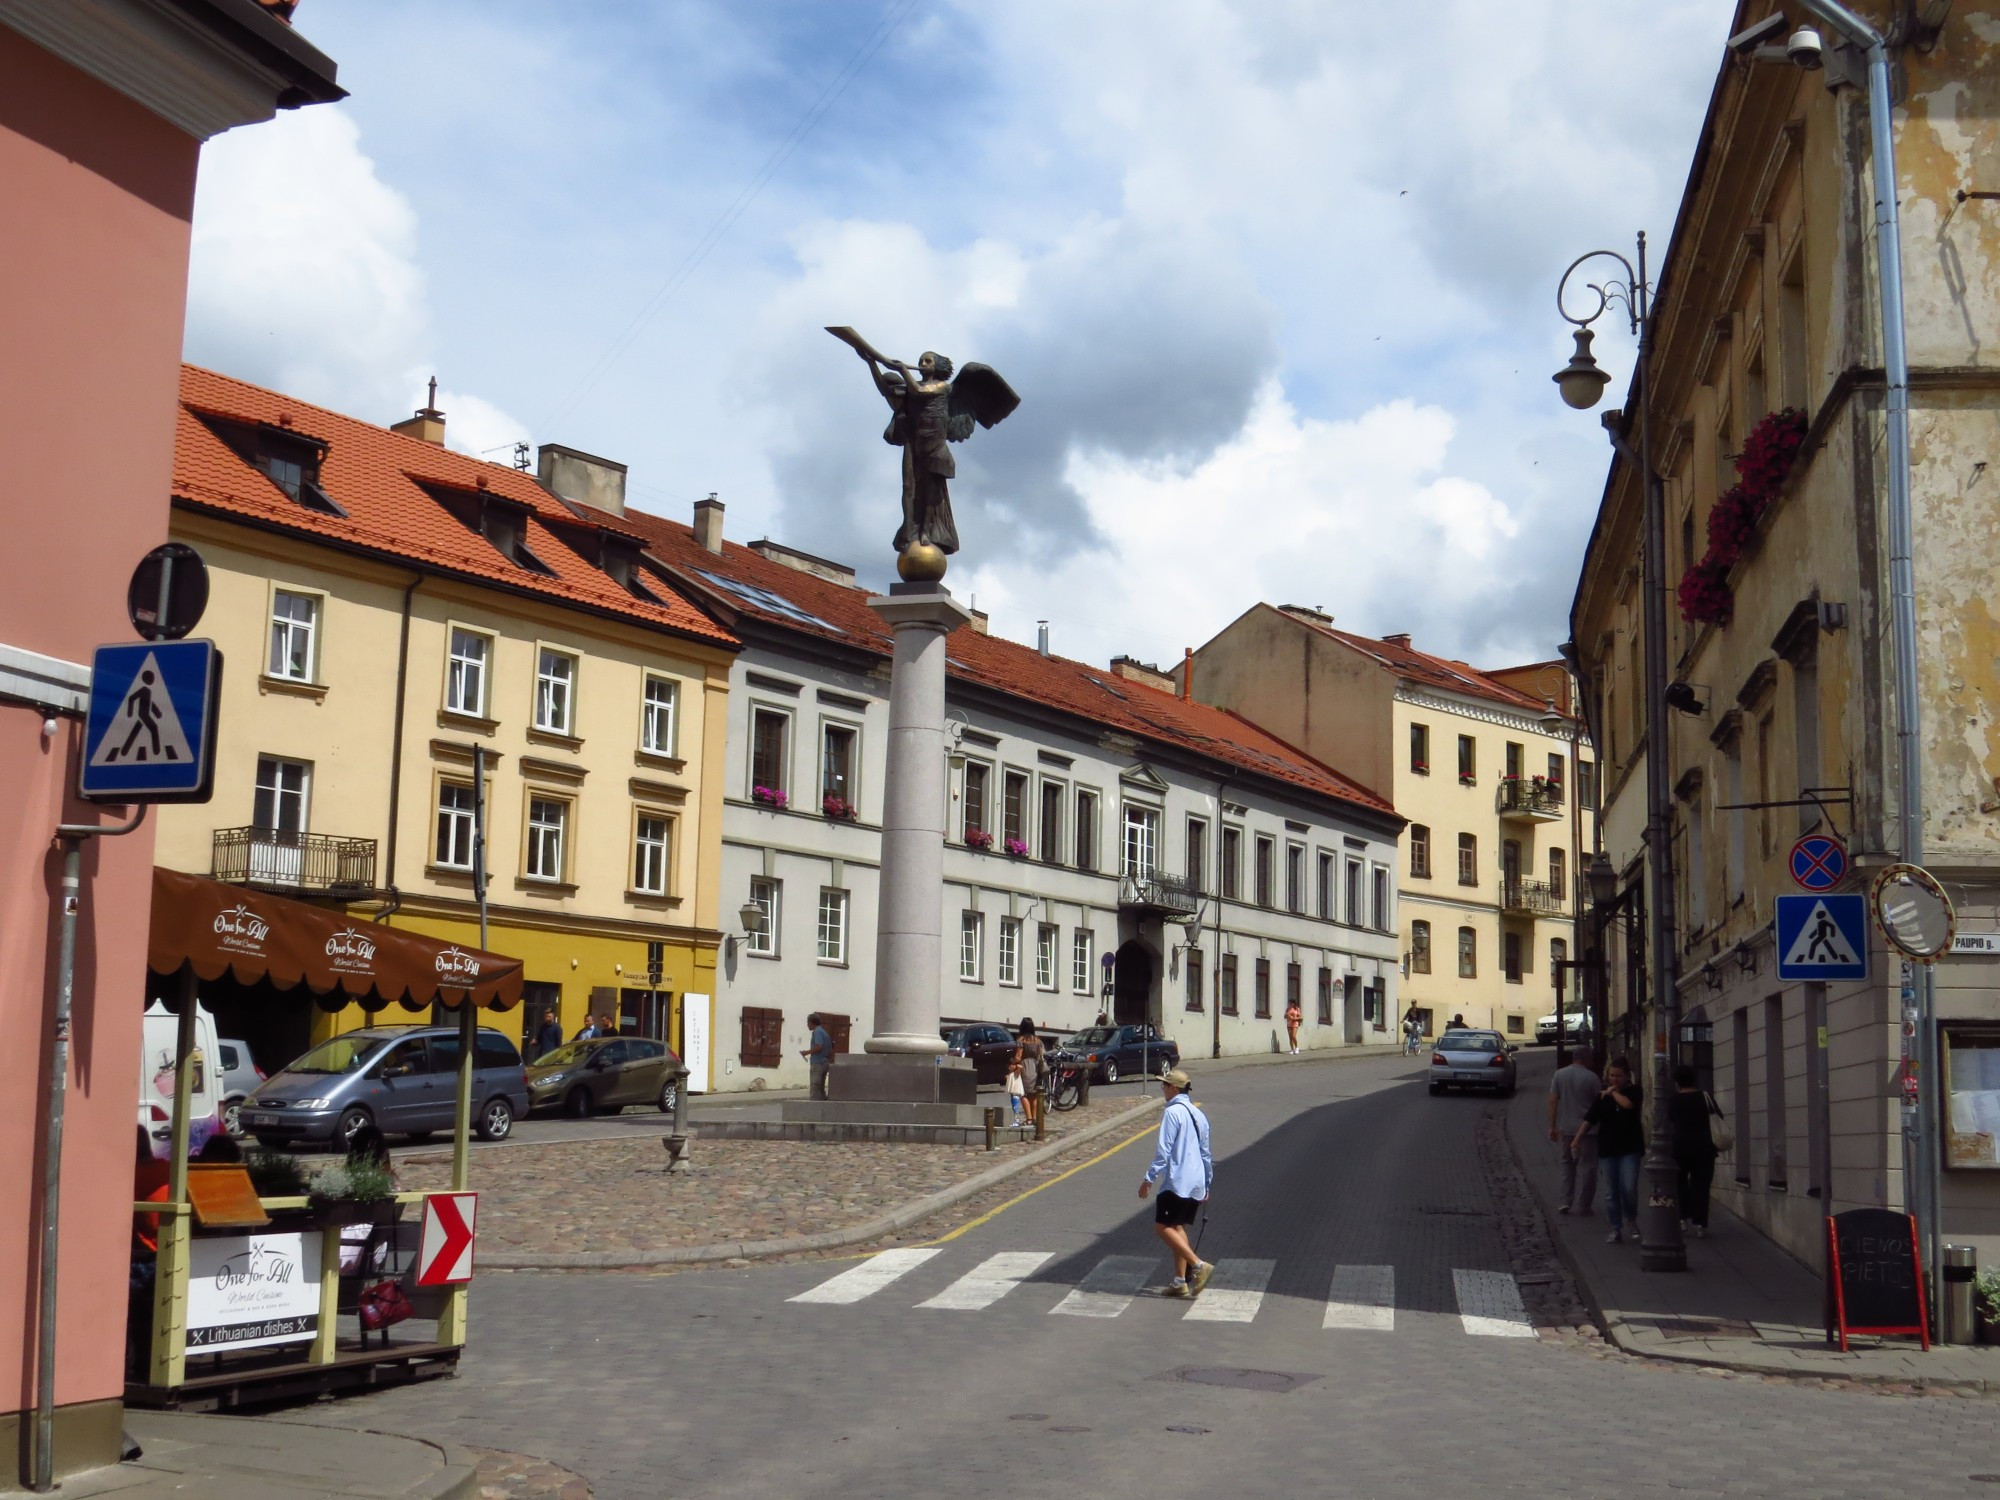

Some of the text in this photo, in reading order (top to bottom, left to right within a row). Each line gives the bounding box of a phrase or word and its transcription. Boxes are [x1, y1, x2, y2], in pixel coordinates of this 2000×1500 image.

[214, 914, 270, 941] One for All
[325, 938, 377, 960] One for All
[1955, 937, 1994, 950] PAUPIO g.
[435, 955, 480, 976] One for All
[215, 1258, 294, 1290] One for All
[227, 1291, 256, 1305] World
[208, 1319, 294, 1343] Lithuanian dishes
